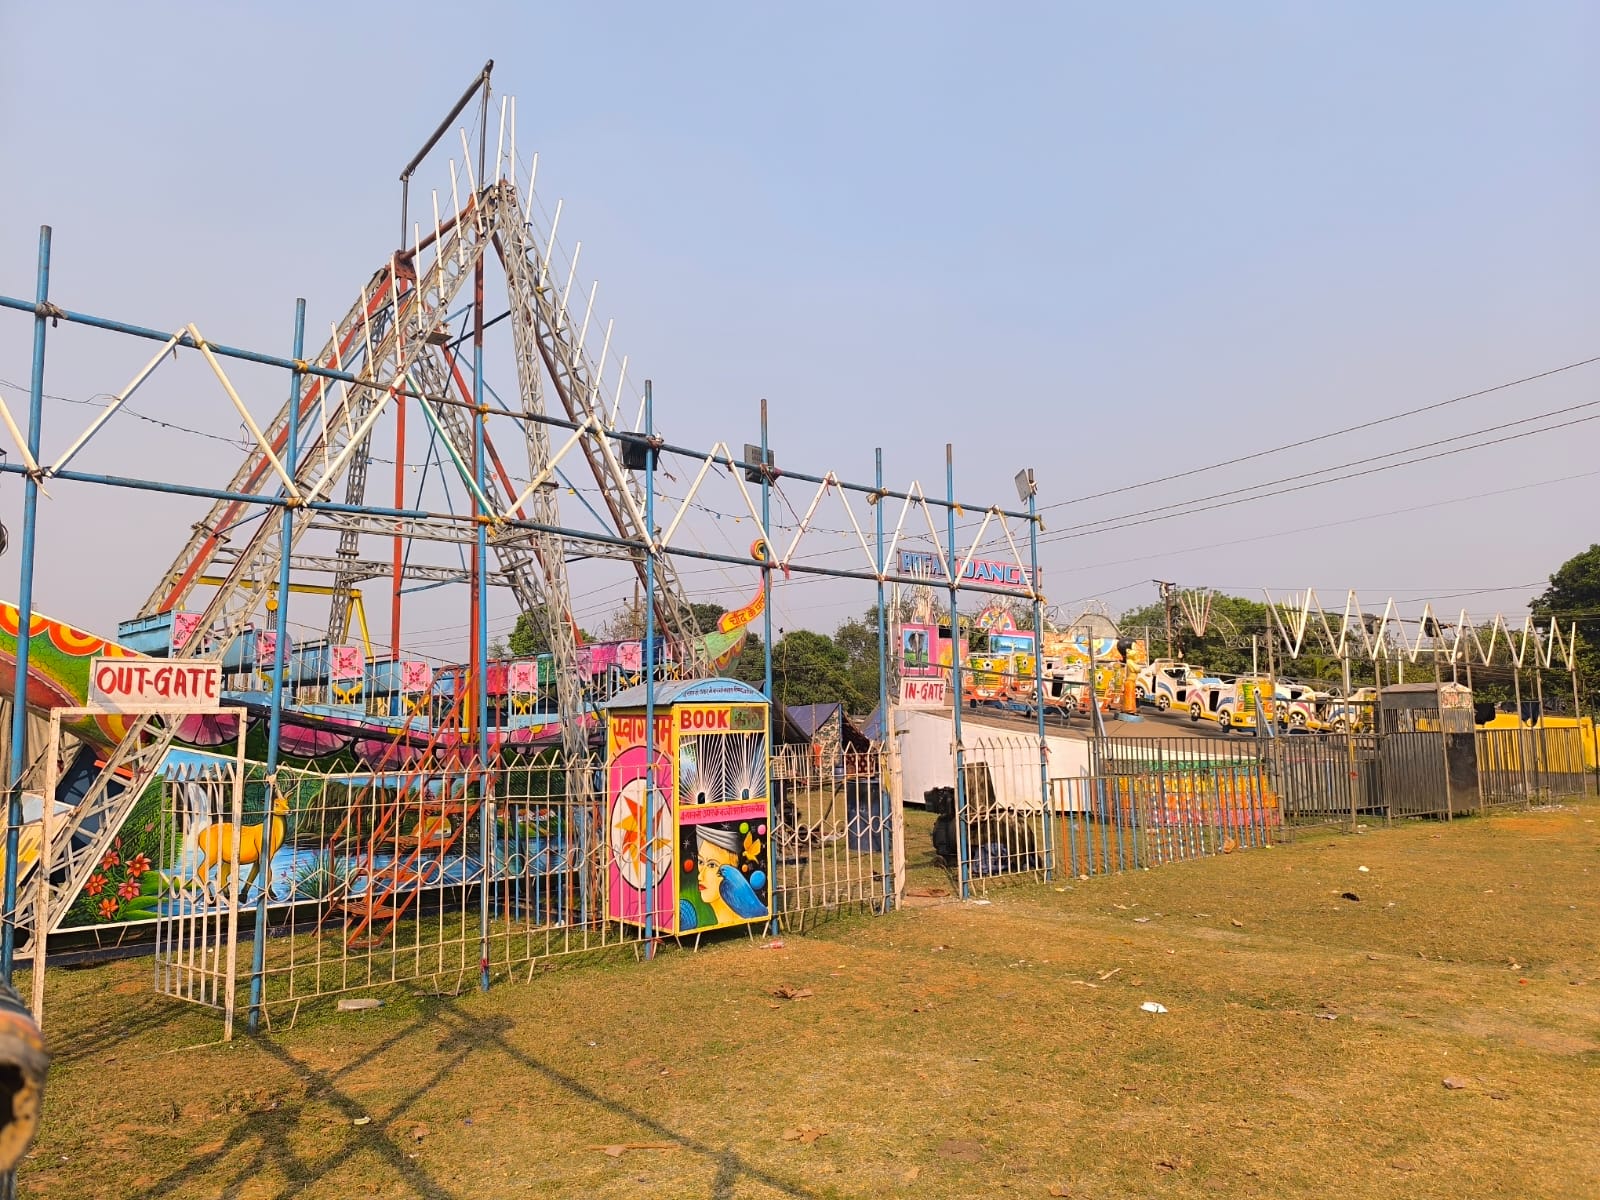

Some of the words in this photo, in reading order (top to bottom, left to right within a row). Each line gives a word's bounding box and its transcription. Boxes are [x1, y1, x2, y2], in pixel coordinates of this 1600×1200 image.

[959, 558, 1033, 585] DANCE
[97, 666, 217, 698] OUT-GATE
[905, 682, 944, 701] IN-GATE
[681, 709, 729, 730] BOOK
